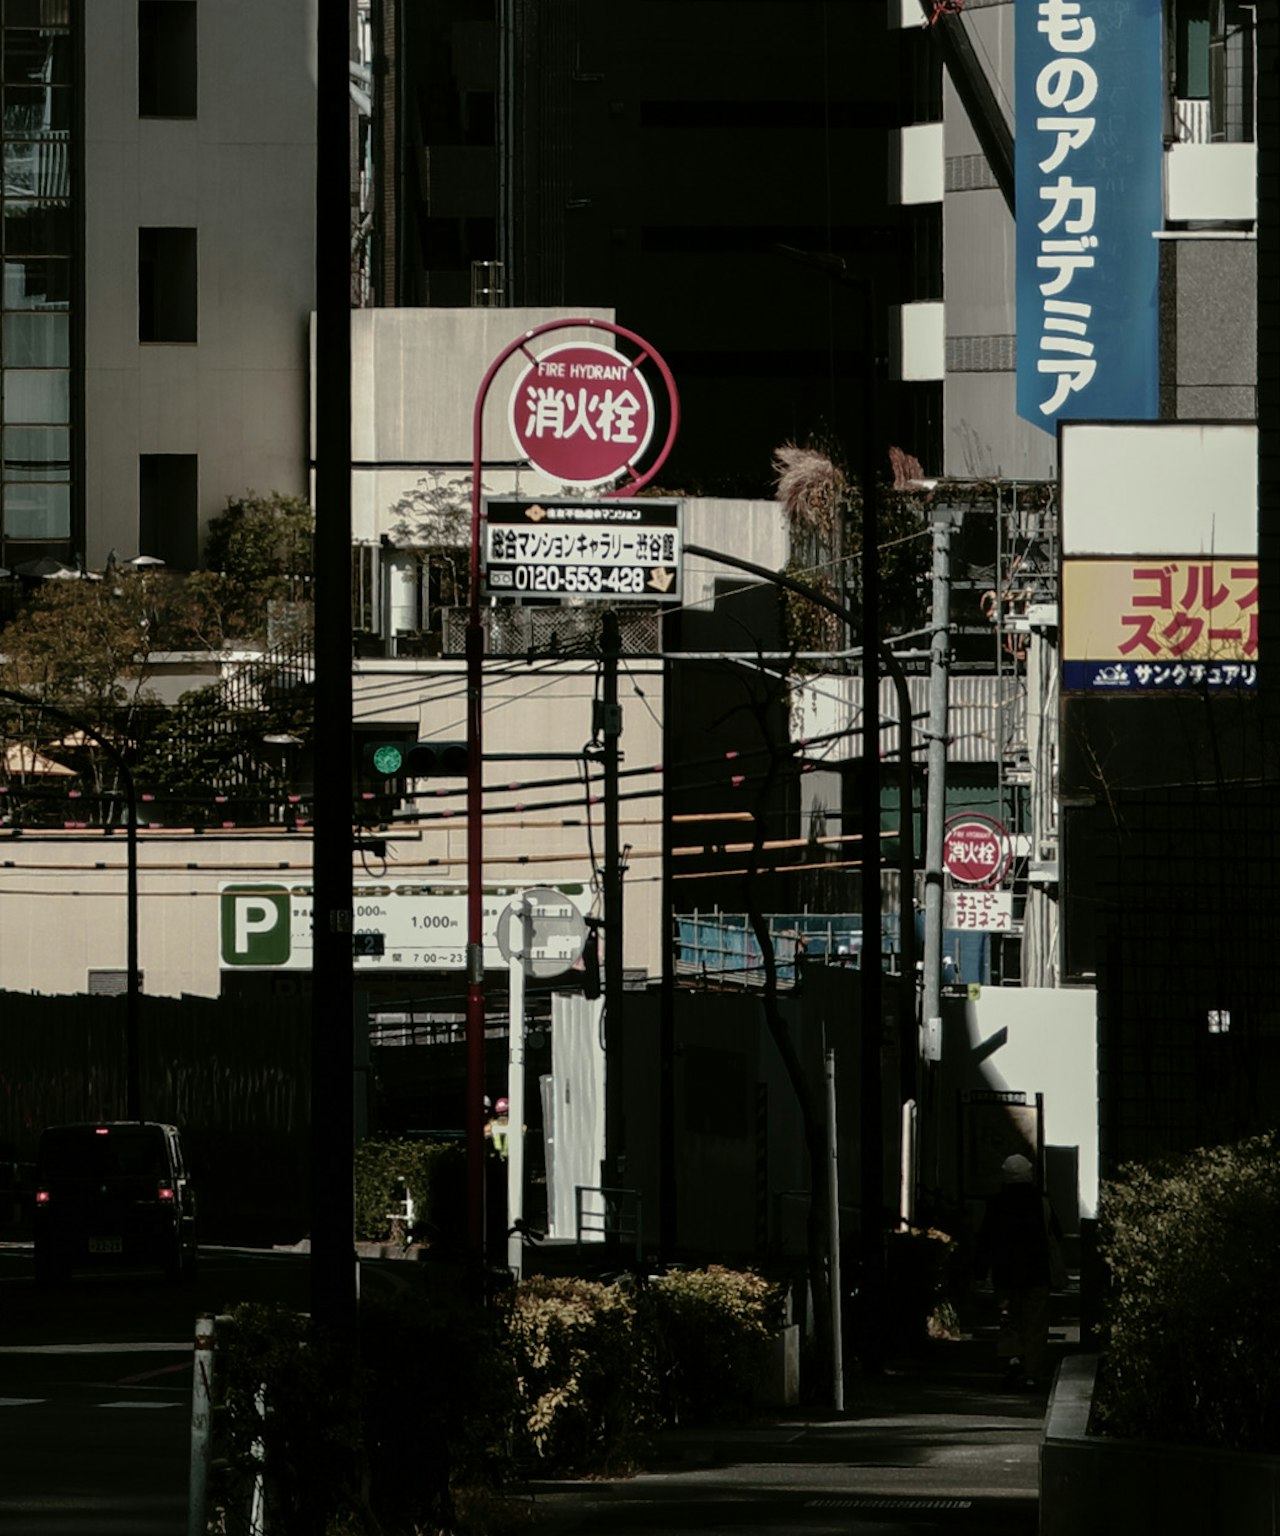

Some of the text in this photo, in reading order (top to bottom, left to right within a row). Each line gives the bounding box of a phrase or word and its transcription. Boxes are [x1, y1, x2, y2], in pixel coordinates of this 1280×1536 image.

[538, 362, 628, 381] FIRE HYDRANT
[525, 386, 641, 444] 消火栓
[515, 566, 644, 593] 0120-553-428
[948, 841, 996, 865] 消火栓
[234, 896, 278, 953] P
